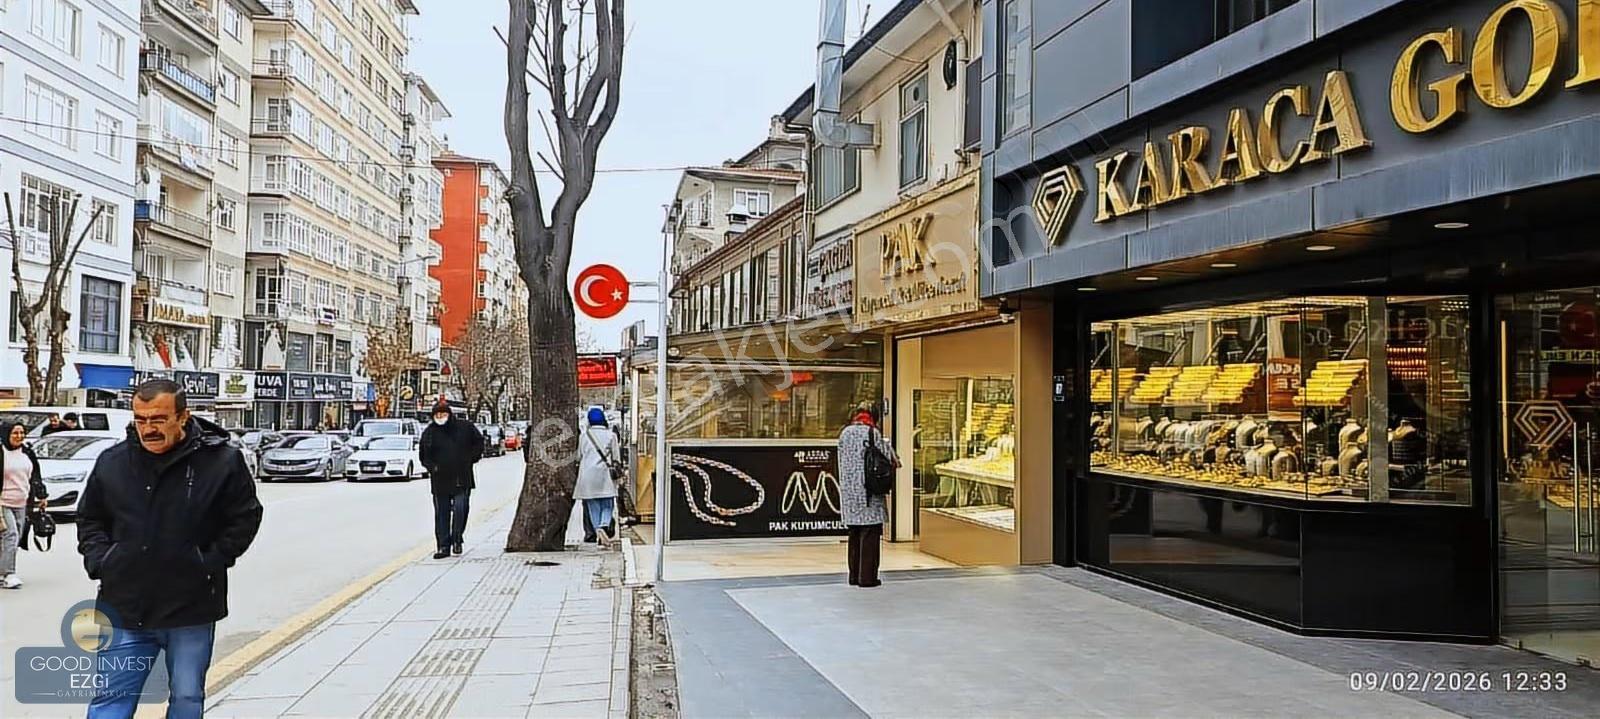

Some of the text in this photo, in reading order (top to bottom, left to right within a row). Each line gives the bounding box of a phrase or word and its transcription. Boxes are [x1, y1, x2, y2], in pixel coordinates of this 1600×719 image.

[1093, 69, 1374, 223] KARACA
[879, 212, 936, 280] PAK
[254, 375, 282, 387] UVA
[769, 521, 788, 531] PAK
